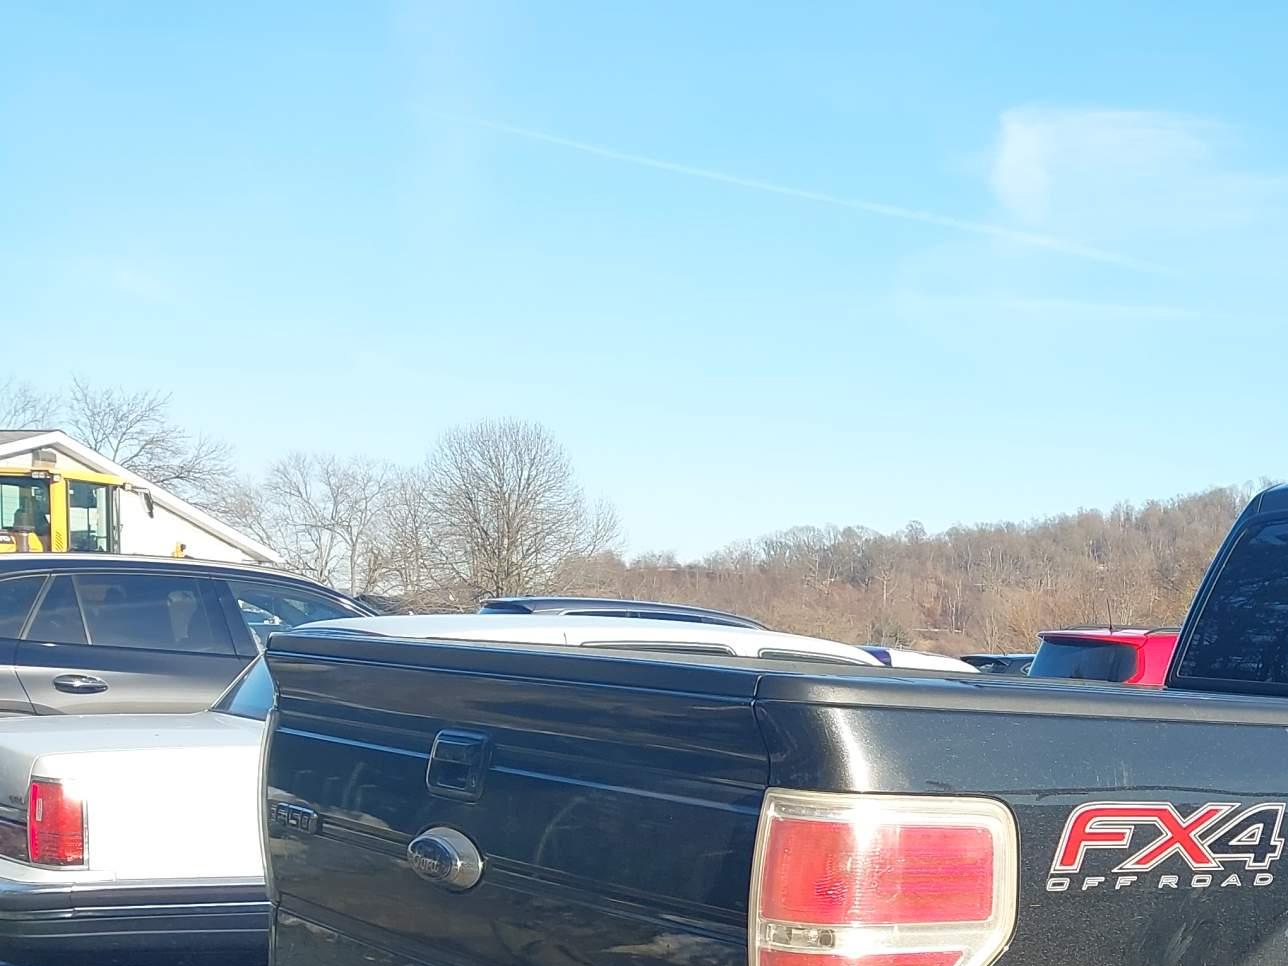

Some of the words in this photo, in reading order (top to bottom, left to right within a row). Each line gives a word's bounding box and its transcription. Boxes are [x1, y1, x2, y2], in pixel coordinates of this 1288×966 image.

[1050, 801, 1286, 873] FX4
[1046, 876, 1138, 891] OFF
[1158, 873, 1274, 889] ROAD
